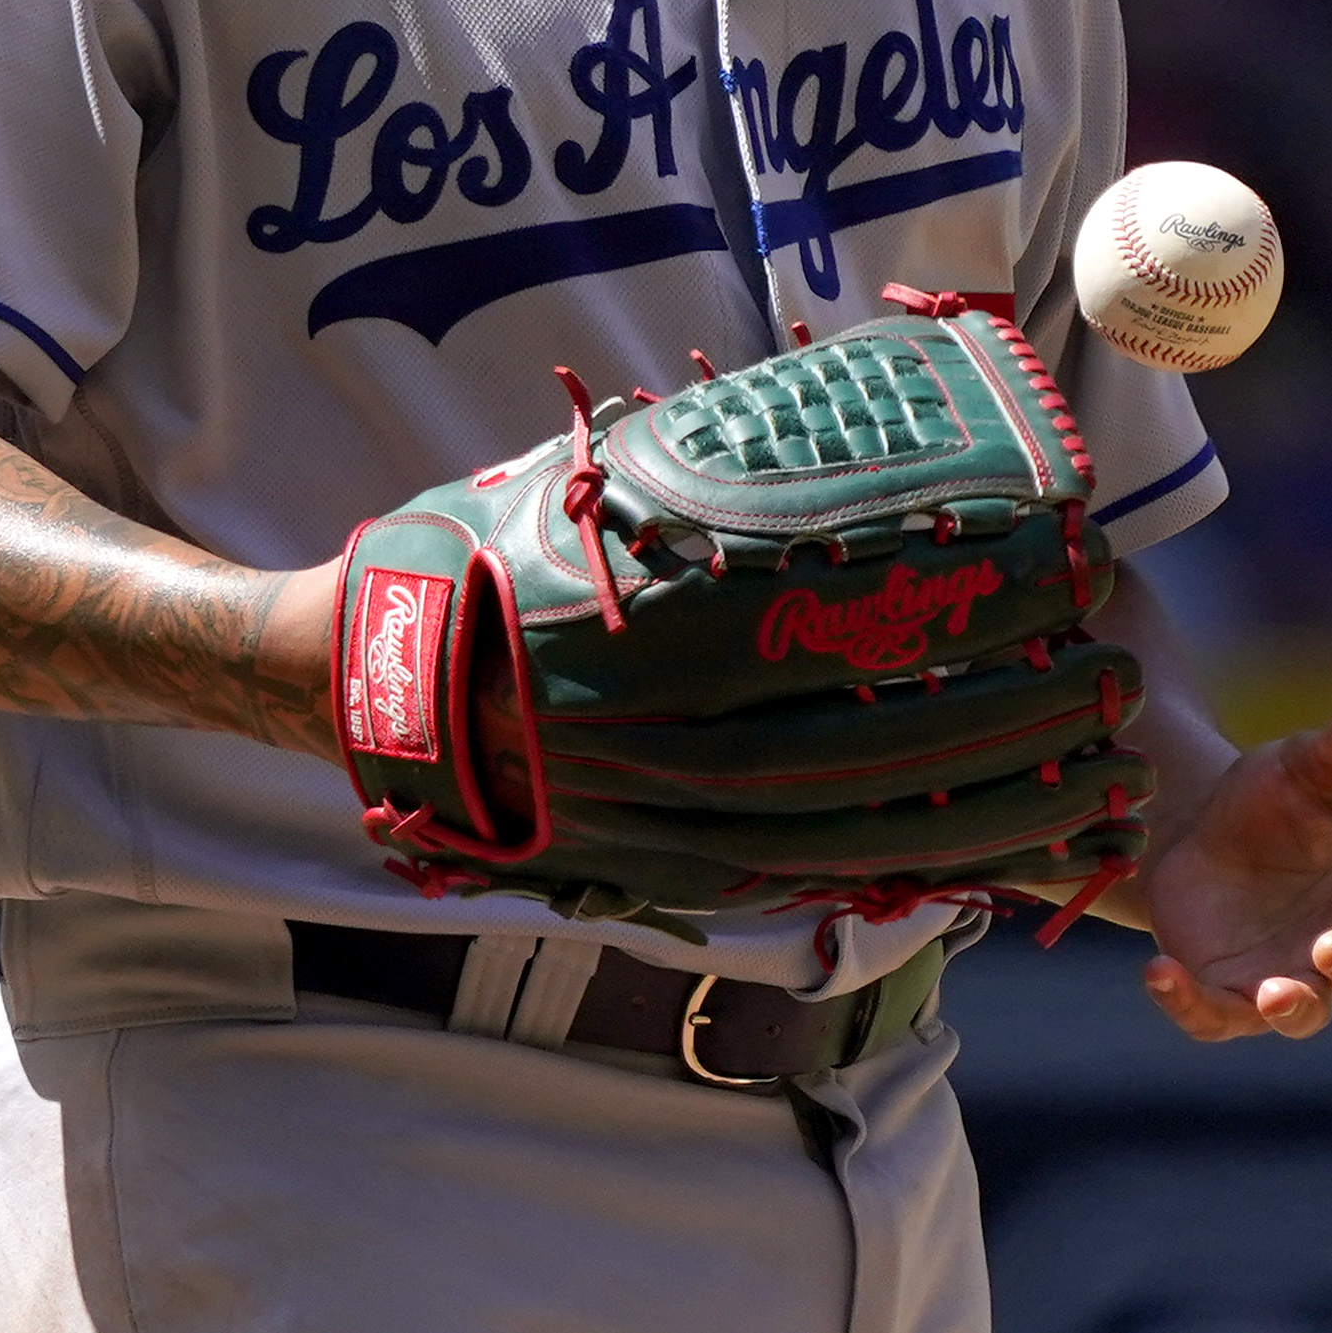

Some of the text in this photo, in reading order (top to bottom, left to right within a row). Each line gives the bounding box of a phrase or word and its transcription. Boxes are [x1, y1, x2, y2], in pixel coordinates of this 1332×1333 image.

[245, 20, 533, 254] Los
[1159, 213, 1246, 253] Rawlings
[1152, 314, 1185, 331] LEAGUE
[1185, 323, 1232, 335] BASEBALL
[1159, 305, 1196, 322] OFFICIAL
[756, 557, 1005, 662] Rawlings
[373, 585, 418, 743] Rawlings
